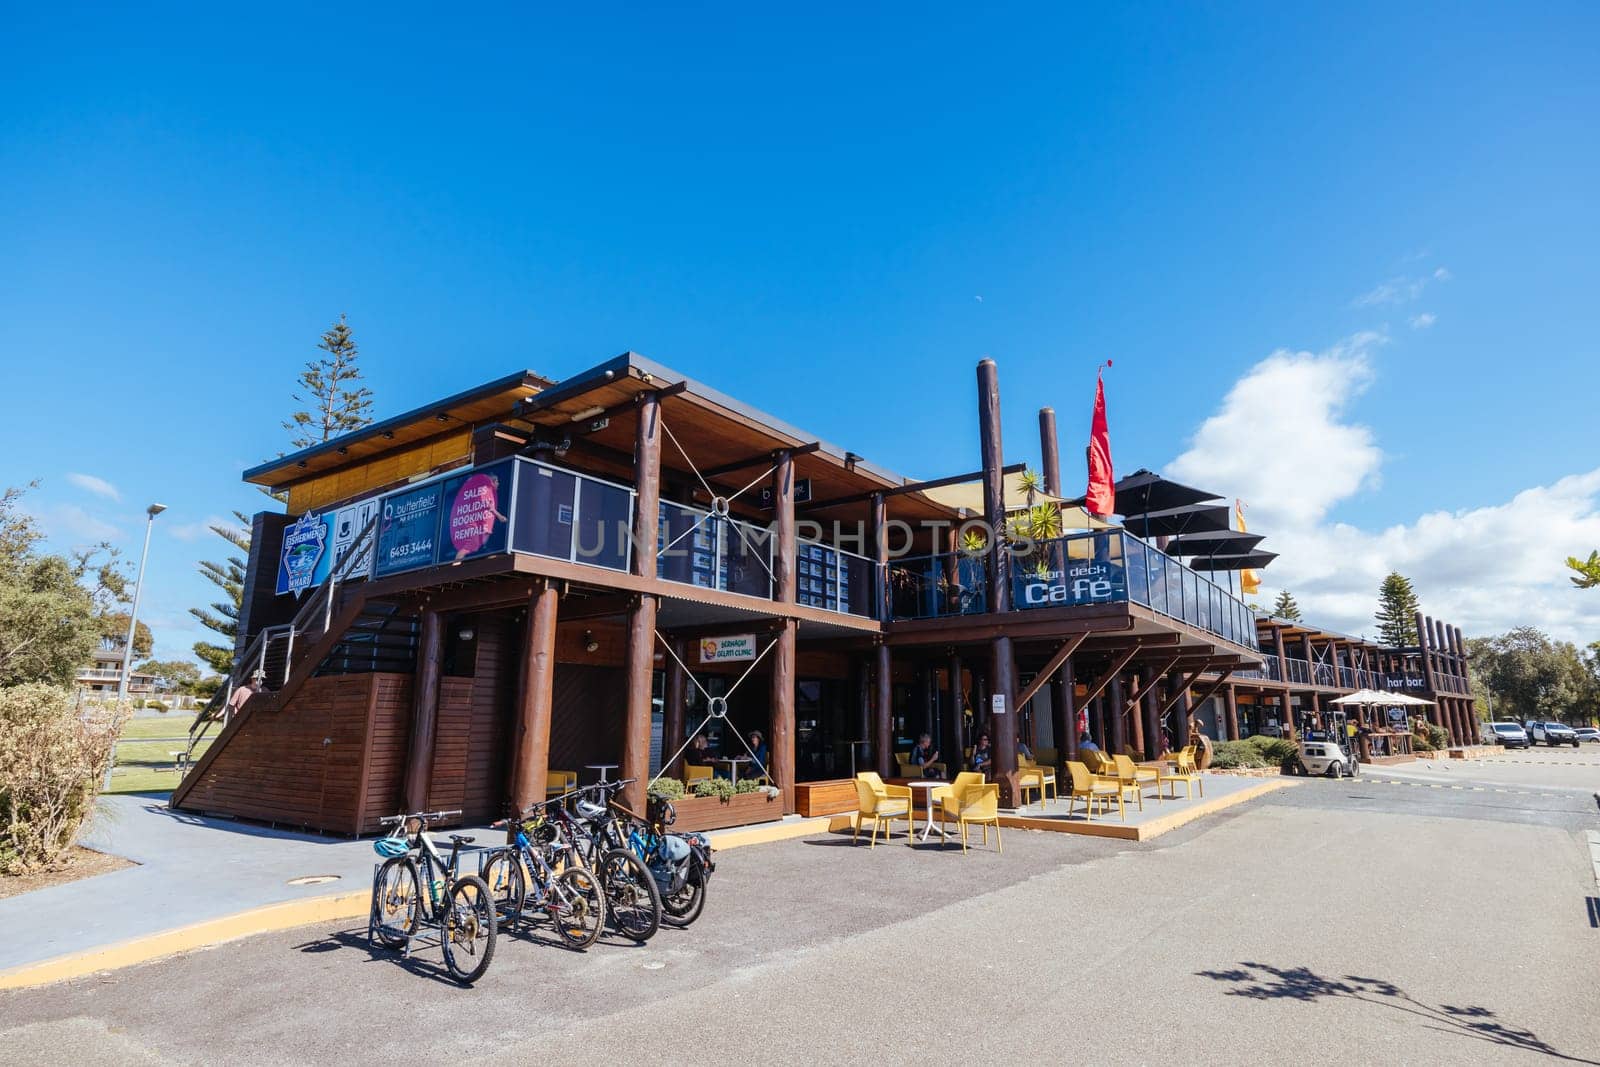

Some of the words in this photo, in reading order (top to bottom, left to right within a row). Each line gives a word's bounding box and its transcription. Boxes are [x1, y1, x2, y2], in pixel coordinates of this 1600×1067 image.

[463, 486, 488, 501] SALES
[397, 494, 436, 515] butterfield
[456, 498, 492, 516] HOLIDAY
[452, 510, 494, 528] BOOKINGS
[454, 524, 489, 541] RENTALS
[390, 543, 410, 559] 6493
[410, 539, 432, 553] 3444
[1069, 565, 1107, 577] deck
[735, 649, 752, 657] CLINIC
[1387, 676, 1403, 688] har
[1406, 676, 1424, 687] bar
